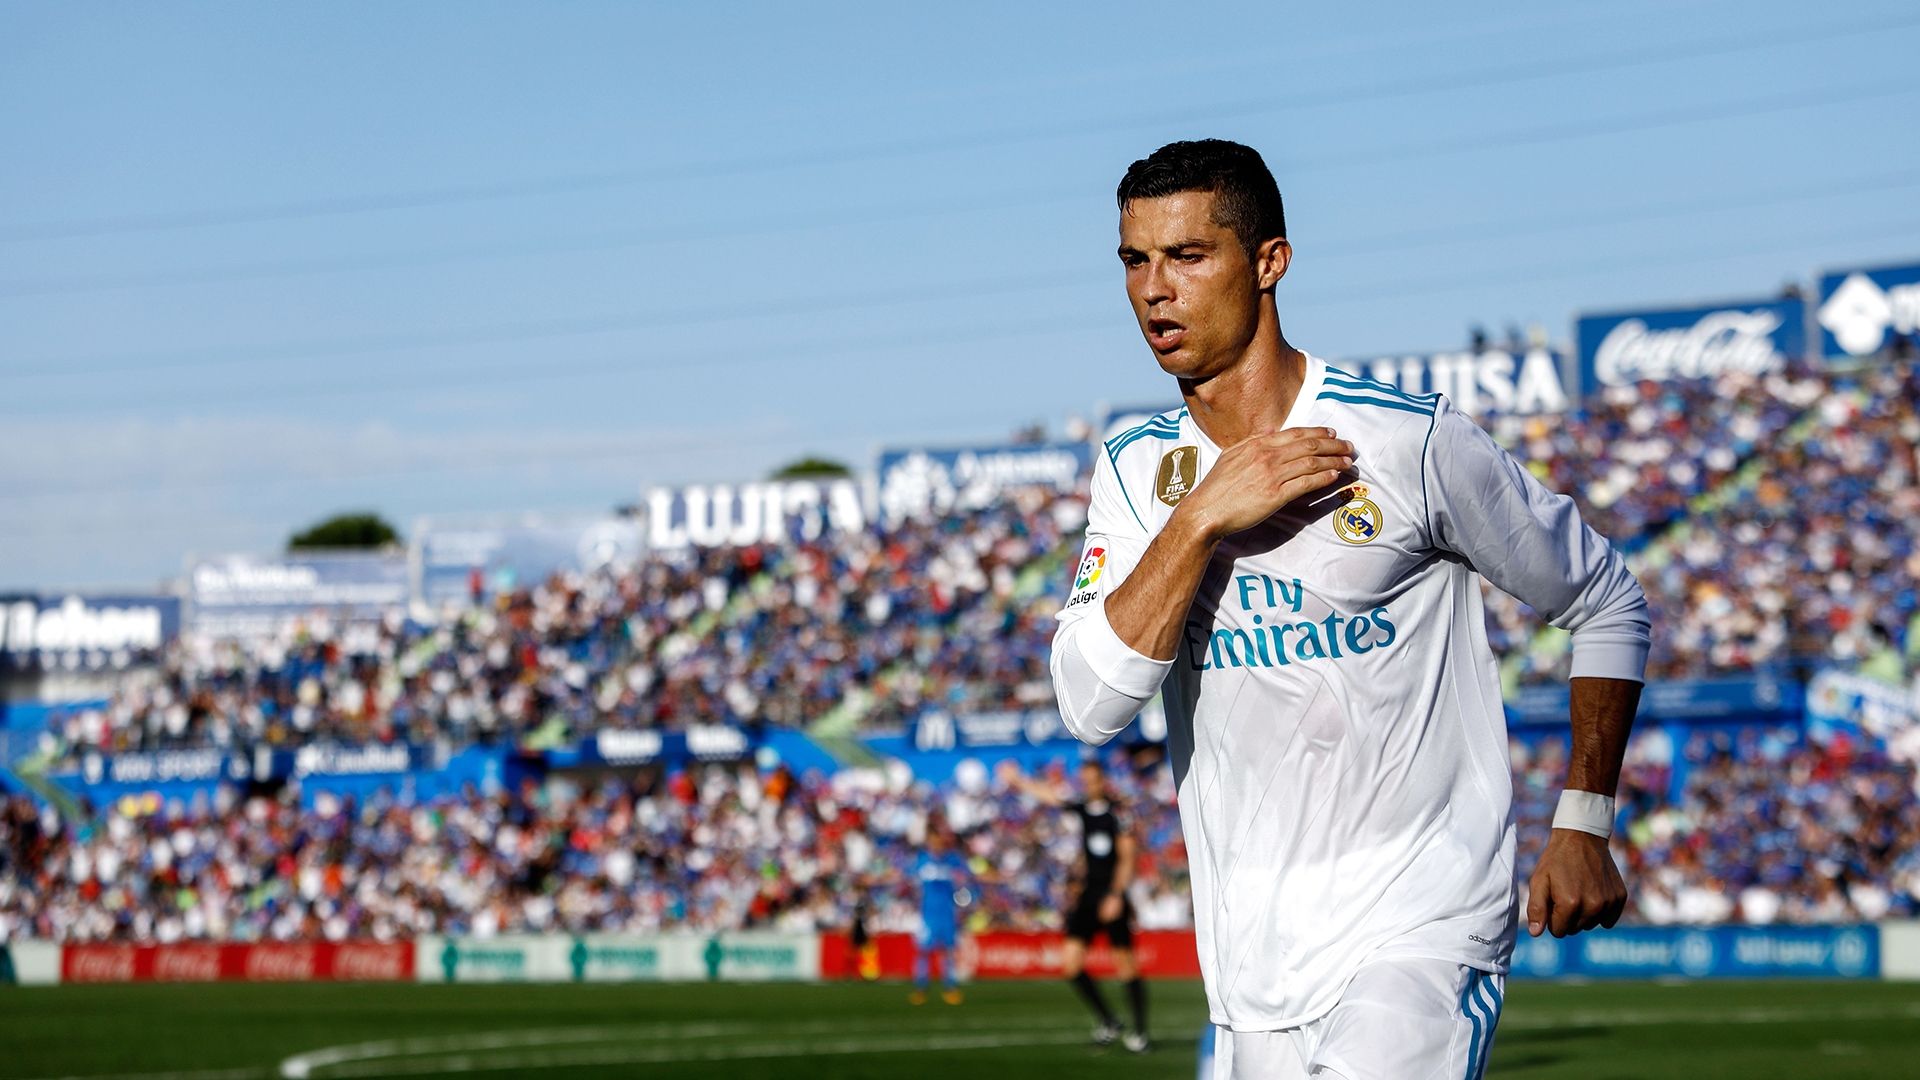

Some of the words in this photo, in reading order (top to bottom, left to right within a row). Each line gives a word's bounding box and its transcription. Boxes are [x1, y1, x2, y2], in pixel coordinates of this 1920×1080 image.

[1166, 483, 1185, 496] FIFA
[1235, 574, 1304, 613] Fly
[1185, 607, 1396, 671] Emirates
